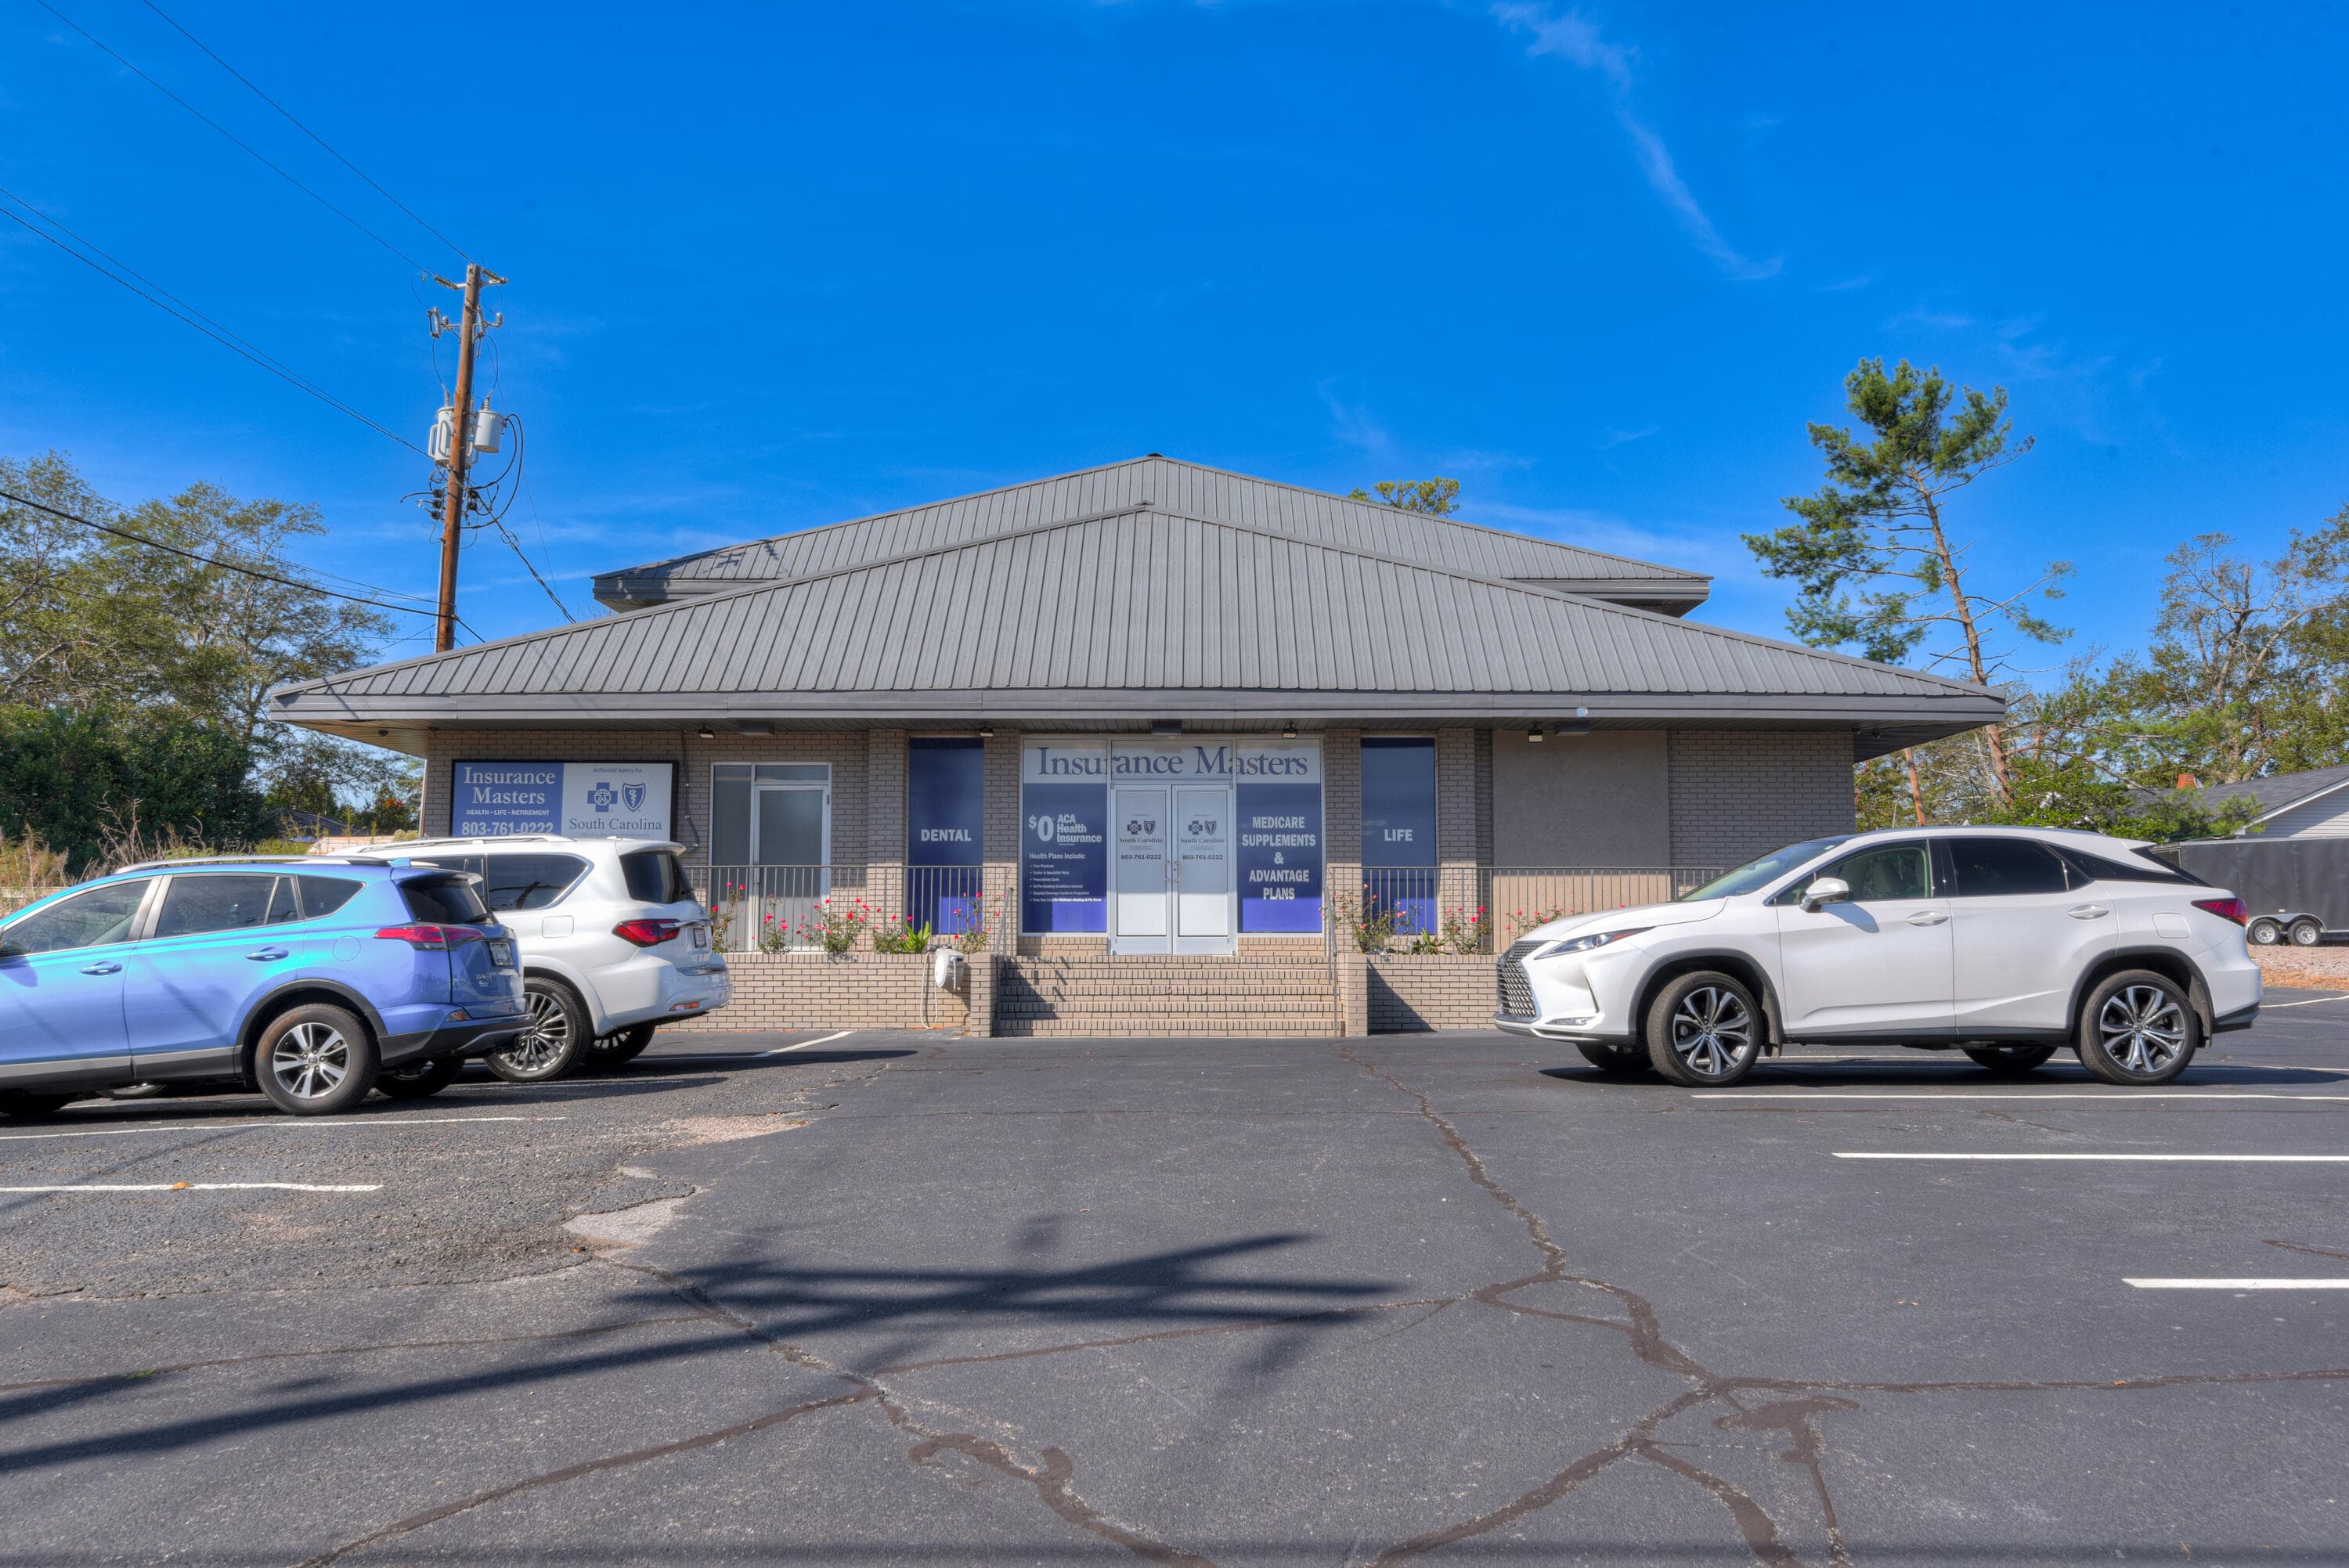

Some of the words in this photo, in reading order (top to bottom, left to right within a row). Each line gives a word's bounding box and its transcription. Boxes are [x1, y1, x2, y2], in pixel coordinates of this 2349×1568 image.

[1037, 747, 1184, 776] Insurance
[1193, 746, 1308, 776] Masters
[464, 766, 556, 784] Insurance
[472, 787, 545, 805] Masters
[570, 818, 604, 830] South
[609, 818, 662, 830] Carolina
[1057, 814, 1076, 824] ACA
[1253, 816, 1305, 829] MEDICARE
[461, 822, 554, 835] 803-761-0222
[1057, 824, 1087, 833] Health
[921, 829, 972, 842] DENTAL
[1057, 833, 1102, 842] Insurance
[1242, 834, 1316, 846] SUPPLEMENTS
[1384, 829, 1413, 842] LIFE
[1274, 852, 1284, 864] &
[1249, 870, 1309, 882] ADVANTAGE
[1263, 887, 1295, 900] PLANS
